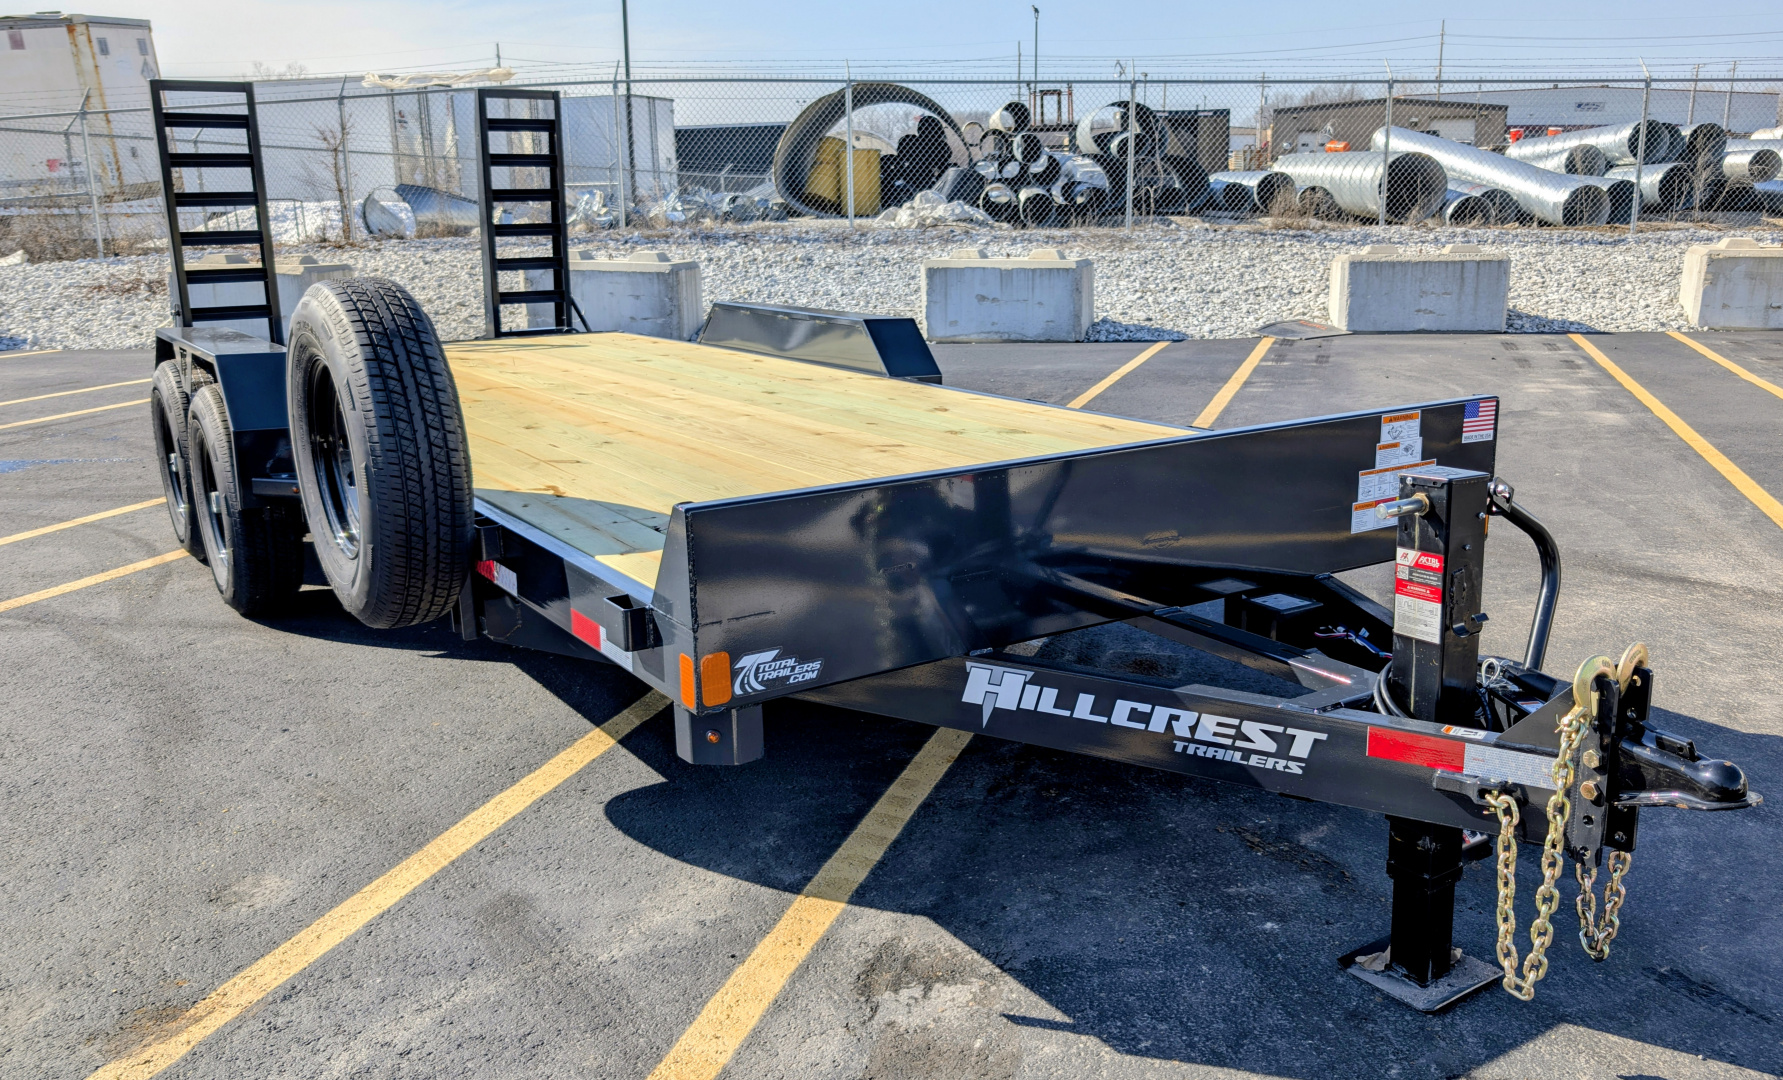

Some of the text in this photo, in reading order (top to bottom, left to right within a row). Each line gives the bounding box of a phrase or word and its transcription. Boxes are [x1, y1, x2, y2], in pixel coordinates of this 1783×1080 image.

[757, 661, 822, 682] TRAILERS
[758, 657, 799, 672] TOTAL
[786, 670, 818, 684] .COM
[961, 661, 1329, 759] HILLCREST
[1172, 740, 1306, 775] TRAILERS
